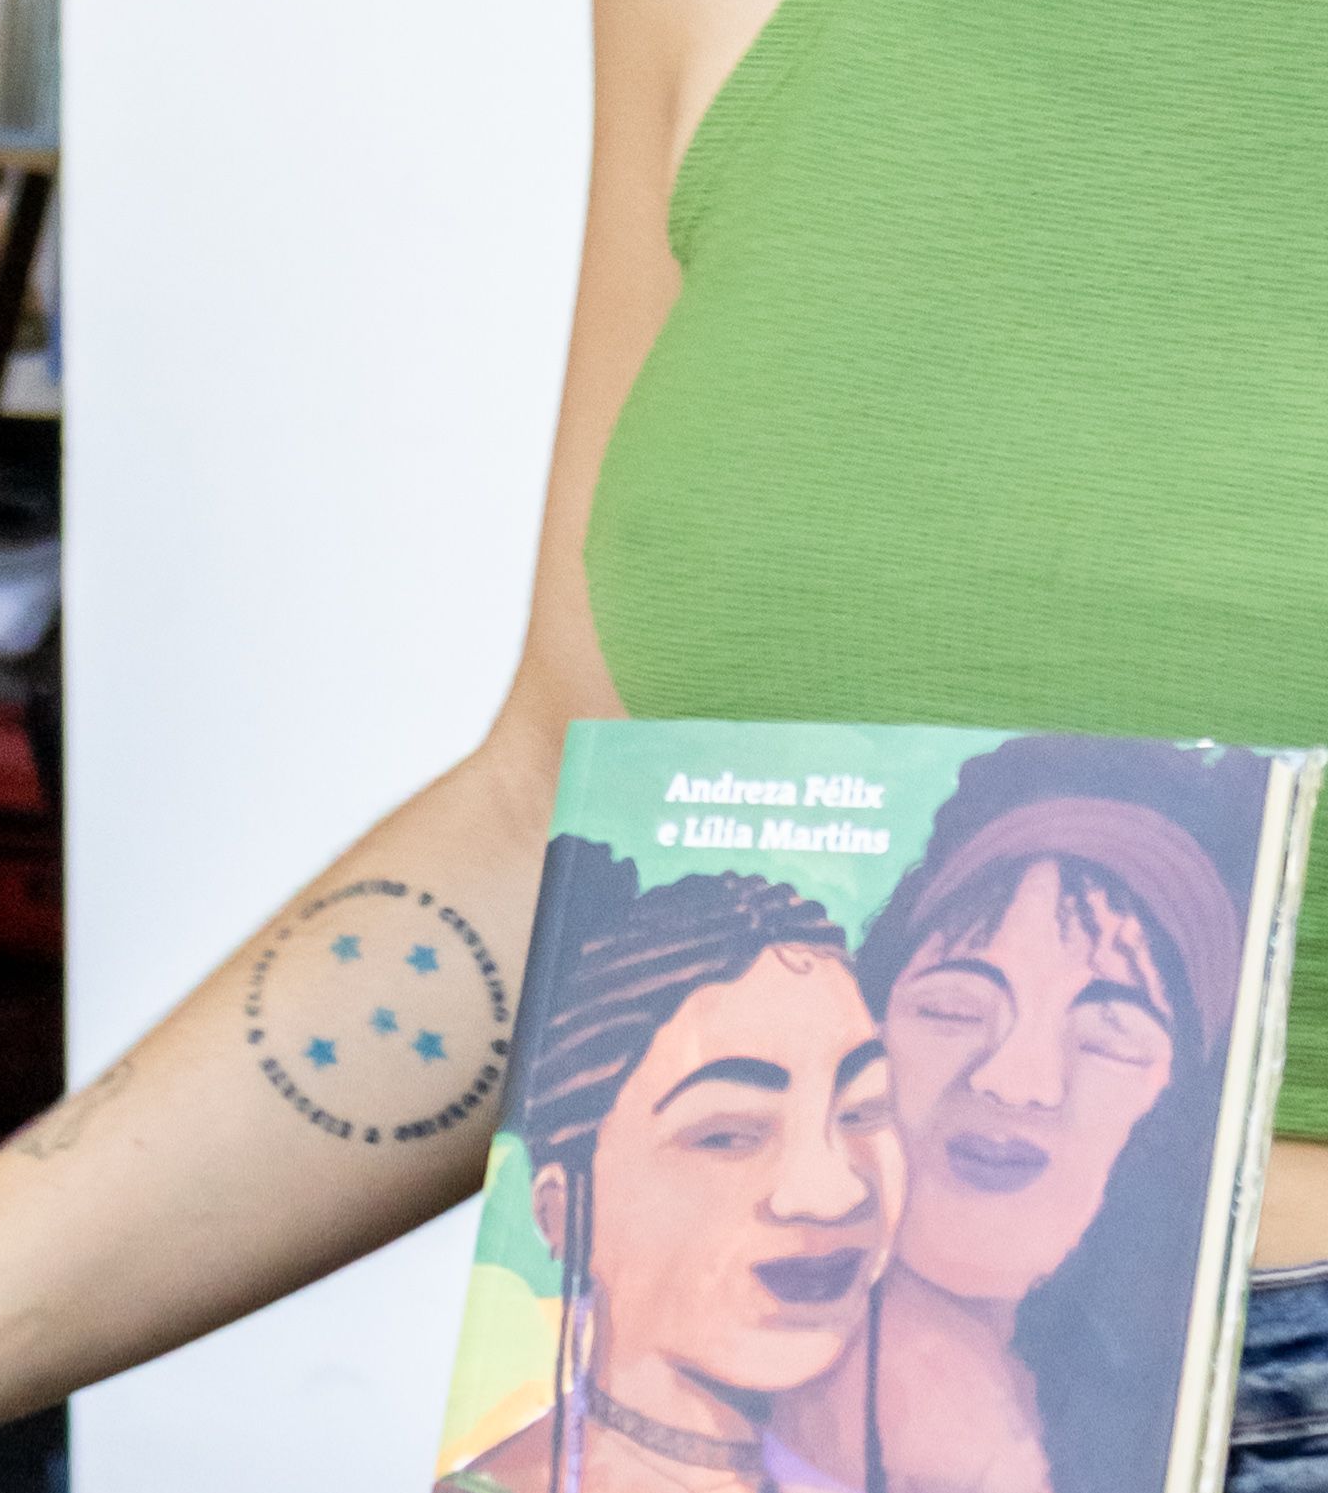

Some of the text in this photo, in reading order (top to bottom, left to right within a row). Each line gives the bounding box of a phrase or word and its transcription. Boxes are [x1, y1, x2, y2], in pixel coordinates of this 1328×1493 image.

[665, 771, 886, 810] Andreza Félix
[656, 820, 679, 847] e
[758, 818, 891, 855] Martins
